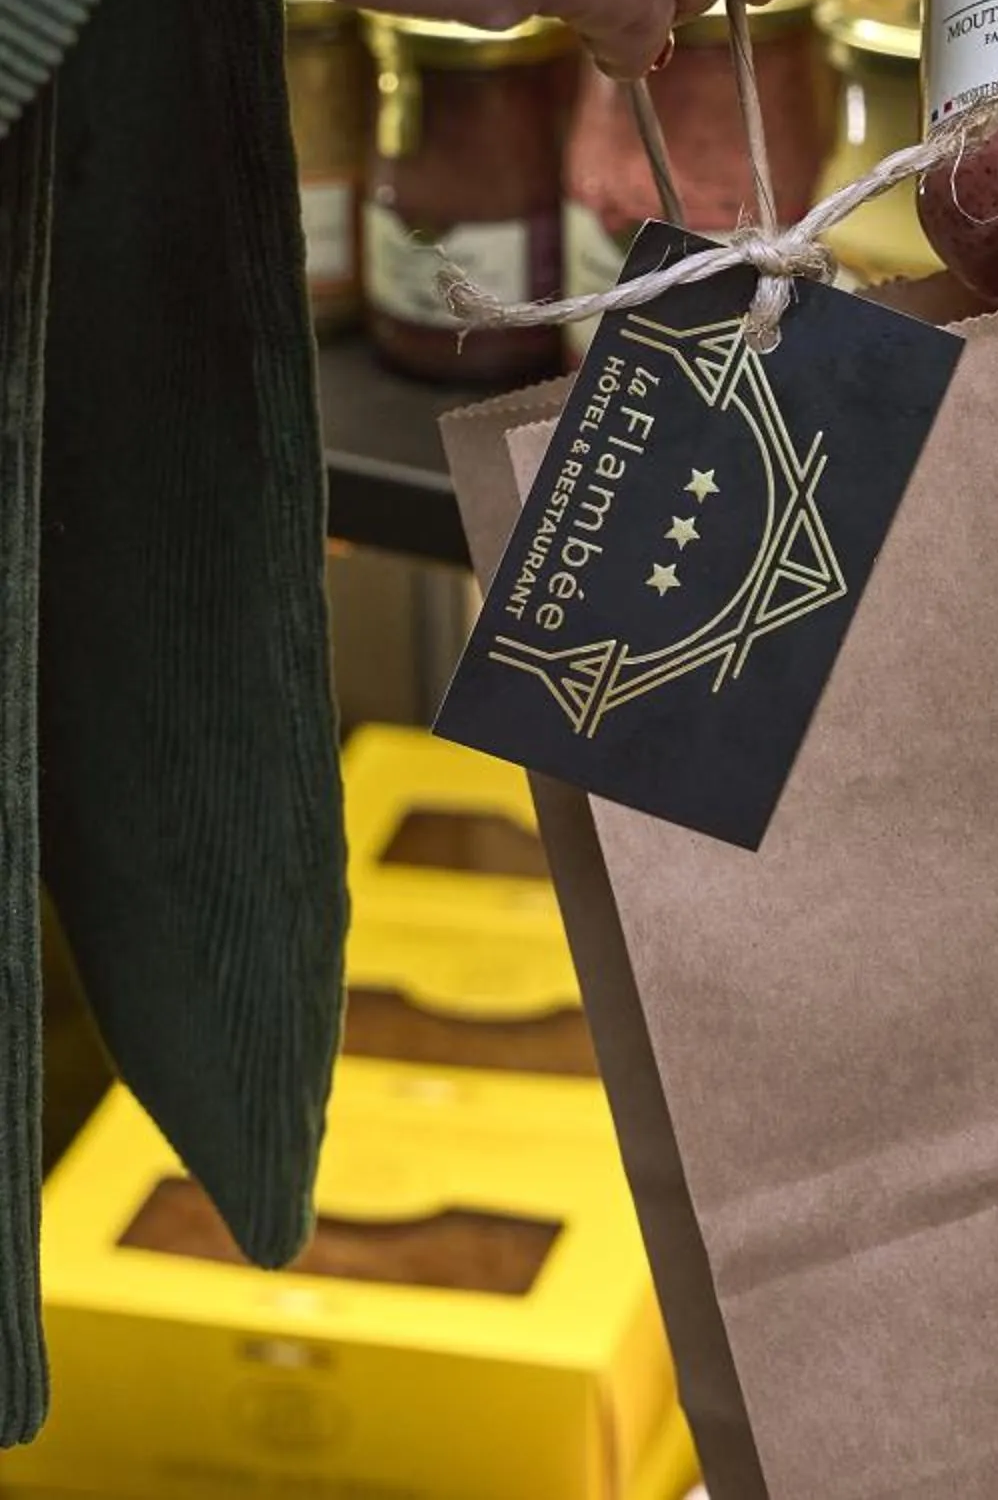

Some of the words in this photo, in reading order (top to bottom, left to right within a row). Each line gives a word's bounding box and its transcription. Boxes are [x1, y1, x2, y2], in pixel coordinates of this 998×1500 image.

[579, 355, 625, 433] HÔTEL
[626, 366, 662, 399] la
[570, 438, 592, 455] &
[505, 459, 583, 621] RESTAURANT
[535, 405, 655, 631] Flambée
